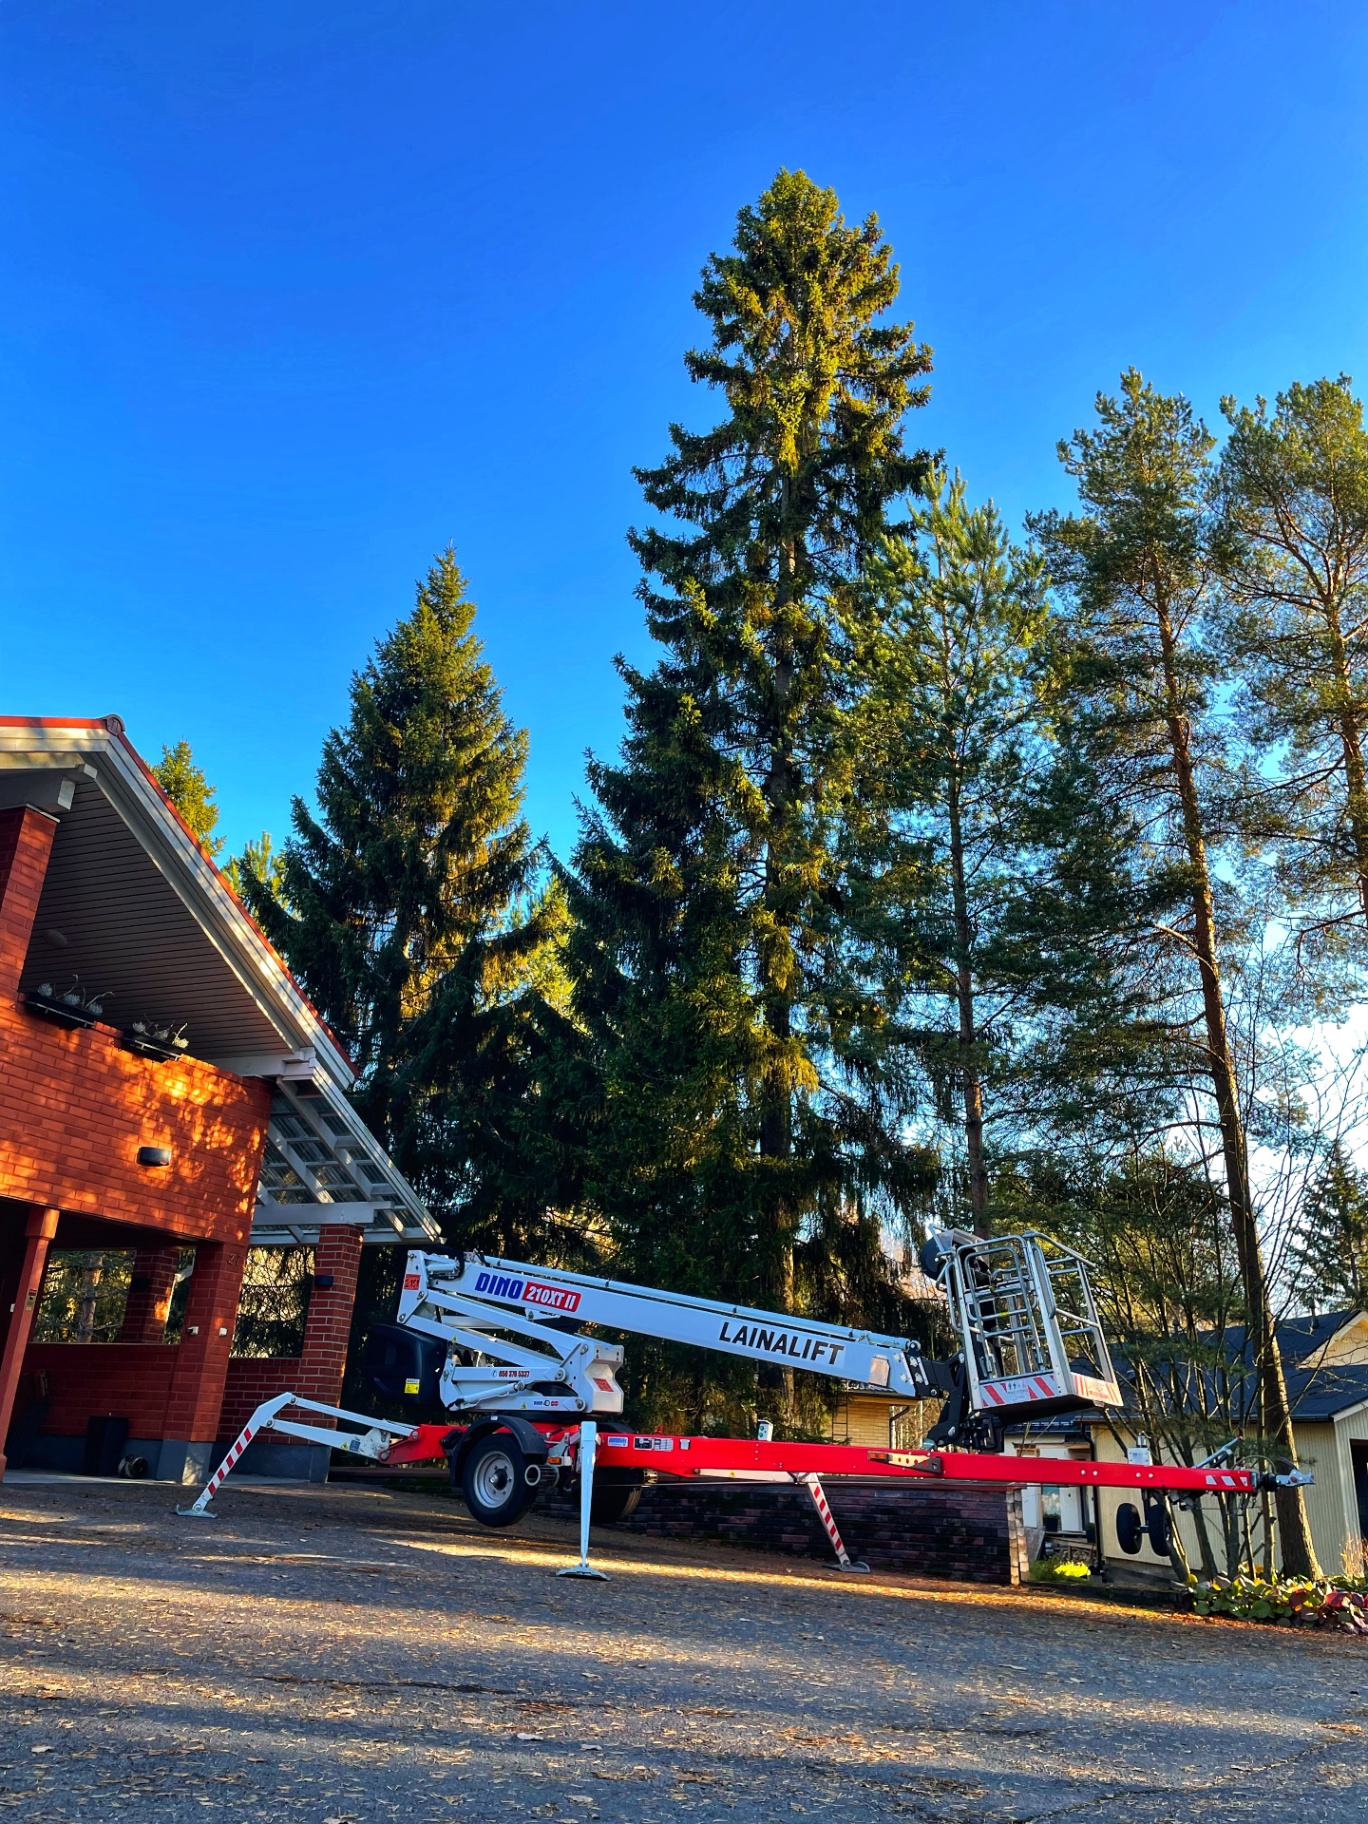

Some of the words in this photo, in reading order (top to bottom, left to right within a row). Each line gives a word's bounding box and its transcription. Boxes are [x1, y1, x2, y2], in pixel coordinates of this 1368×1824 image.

[475, 1272, 524, 1300] DINO
[526, 1286, 565, 1307] 210XT
[719, 1321, 845, 1365] LAINALIFT
